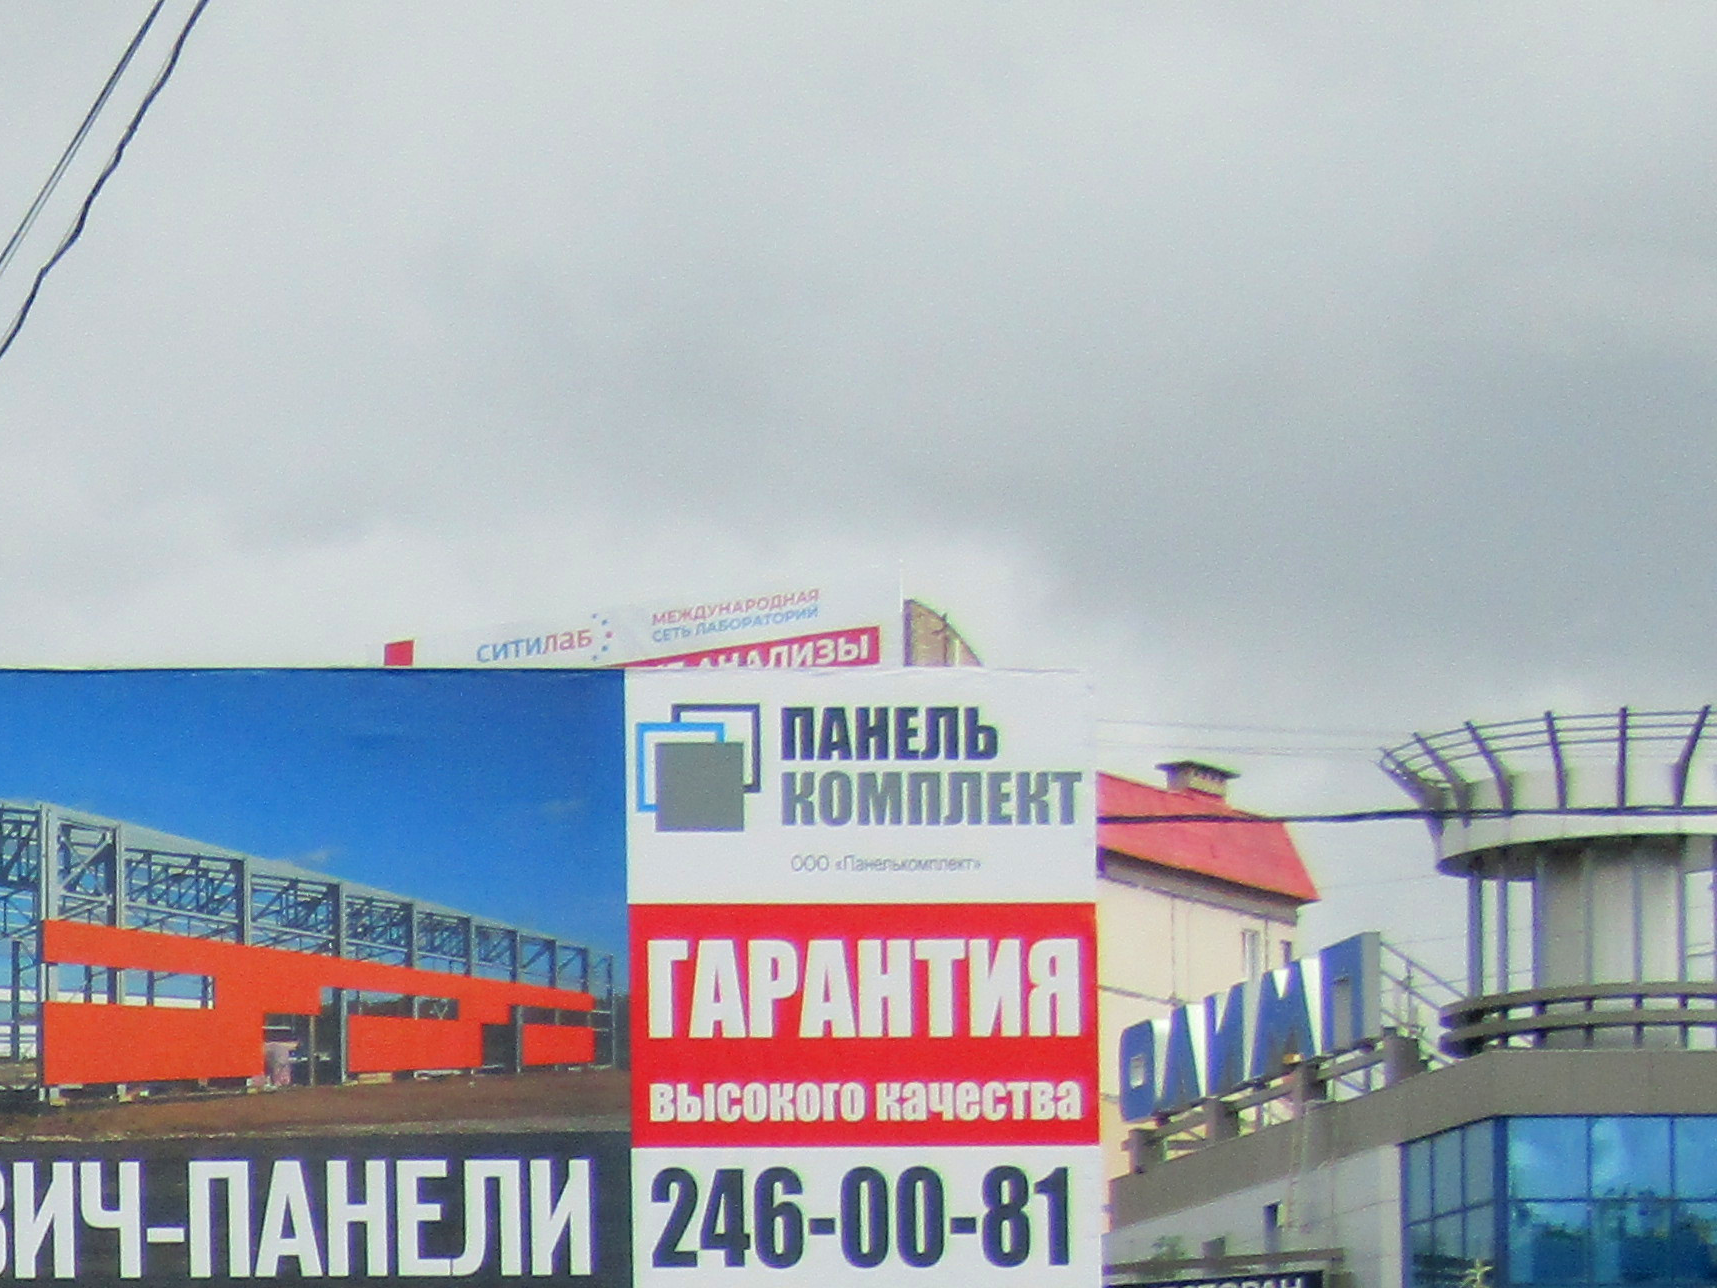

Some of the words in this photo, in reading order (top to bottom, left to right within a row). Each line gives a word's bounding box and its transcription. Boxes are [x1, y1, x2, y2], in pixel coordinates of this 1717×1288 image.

[651, 588, 819, 626] МЕЖДУНАРОДНАЯ
[652, 624, 691, 643] СЕТЬ
[694, 605, 819, 637] ЛАБОРАТОРИЙ
[779, 705, 999, 761] ПАНЕЛЬ
[780, 770, 1083, 827] КОМПЛЕКТ
[790, 855, 830, 872] ООО
[834, 854, 982, 874] «Панелькомплект»
[647, 937, 1081, 1039] ГАРАНТИЯ
[1119, 932, 1380, 1122] ОЛИМП
[648, 1081, 865, 1123] высокого
[875, 1080, 1082, 1121] качества
[650, 1165, 1071, 1269] 246-00-81
